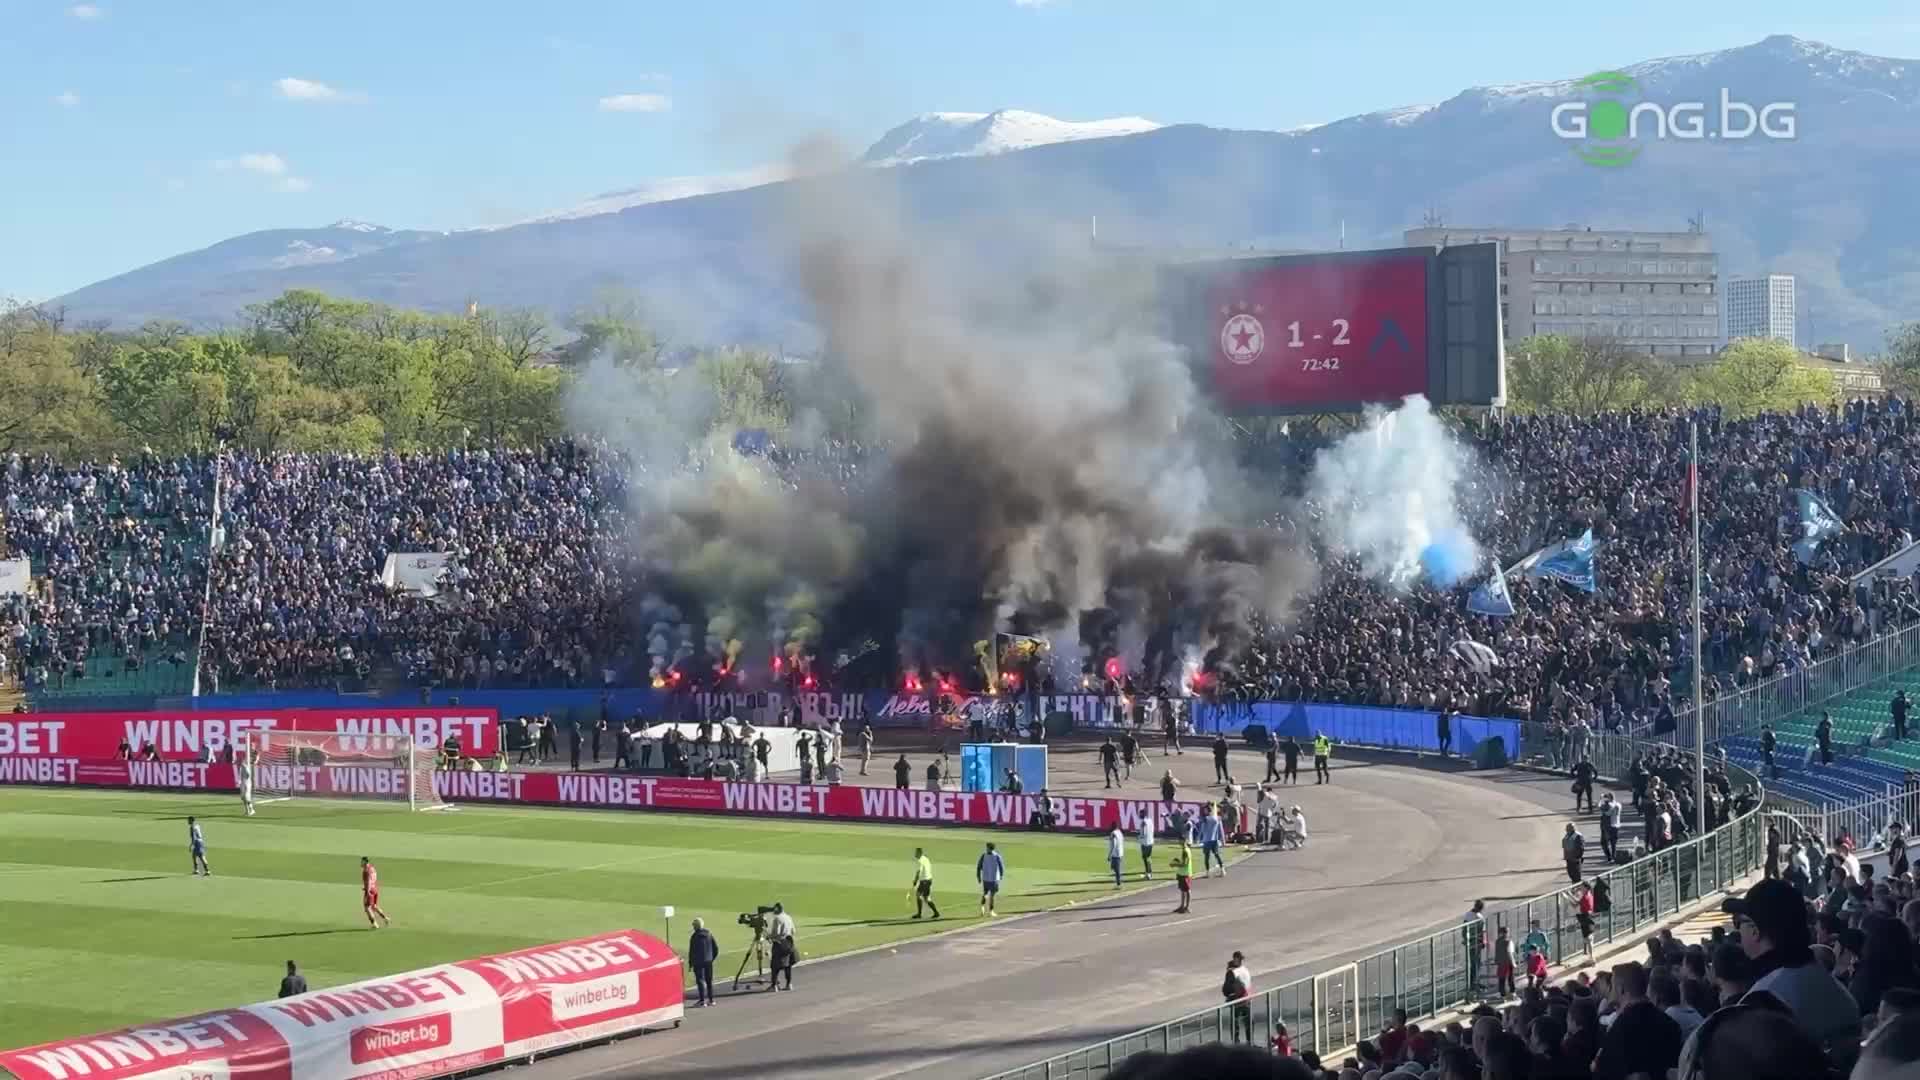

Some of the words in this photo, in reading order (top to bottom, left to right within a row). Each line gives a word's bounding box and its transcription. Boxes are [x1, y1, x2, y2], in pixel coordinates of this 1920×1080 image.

[1287, 321, 1304, 348] 1
[1332, 319, 1350, 346] 2
[1302, 357, 1340, 371] 72:42
[124, 719, 277, 752] WINBET
[336, 716, 489, 750] WINBET
[0, 757, 79, 784] WINBET
[128, 762, 209, 787] WINBET
[432, 770, 525, 799] WINBET
[557, 775, 657, 805] WINBET
[723, 782, 830, 814] WINBET
[861, 788, 975, 822] WINBET
[481, 935, 650, 984] WINBET
[269, 971, 466, 1027] WINBET
[563, 983, 628, 1010] winbet.bg
[16, 1014, 249, 1080] WINBET
[364, 1022, 440, 1051] winbet.bg
